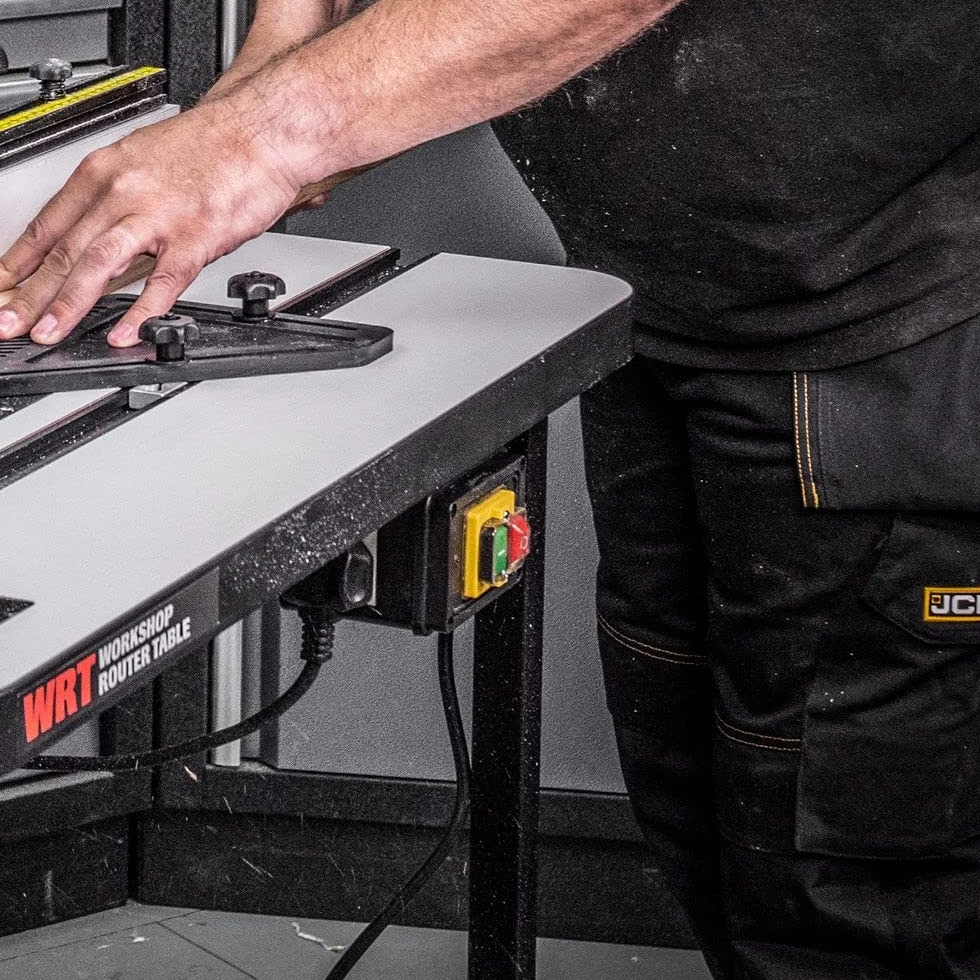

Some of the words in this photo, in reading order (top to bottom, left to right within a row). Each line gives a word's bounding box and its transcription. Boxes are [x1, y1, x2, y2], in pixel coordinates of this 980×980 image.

[98, 603, 175, 670] WORKSHOP
[931, 594, 980, 615] JC
[98, 643, 152, 697] ROUTER
[151, 616, 192, 660] TABLE
[23, 653, 97, 744] WRT
